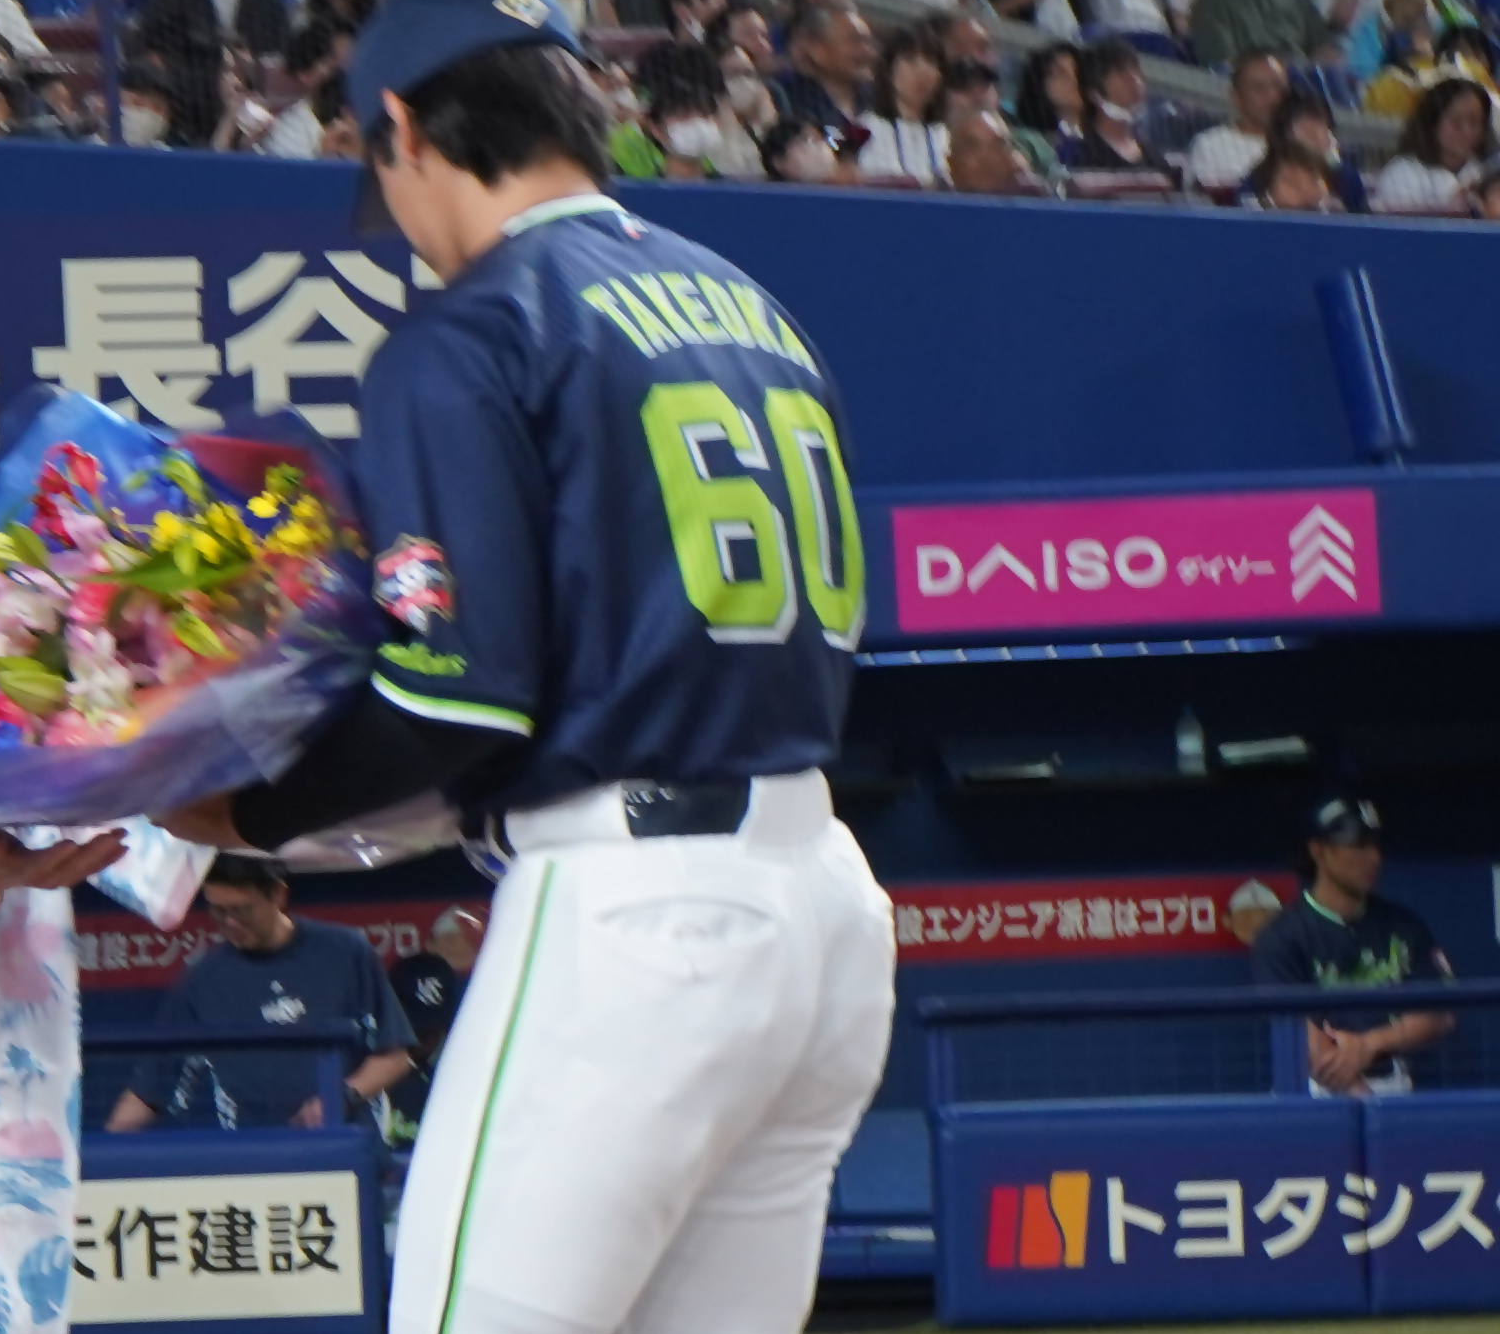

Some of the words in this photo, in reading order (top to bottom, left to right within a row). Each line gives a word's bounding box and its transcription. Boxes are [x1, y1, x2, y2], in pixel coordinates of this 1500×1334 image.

[32, 250, 448, 439] 長谷
[640, 381, 867, 653] 60
[915, 534, 1169, 598] DAISO
[1105, 1171, 1500, 1264] トヨタシス
